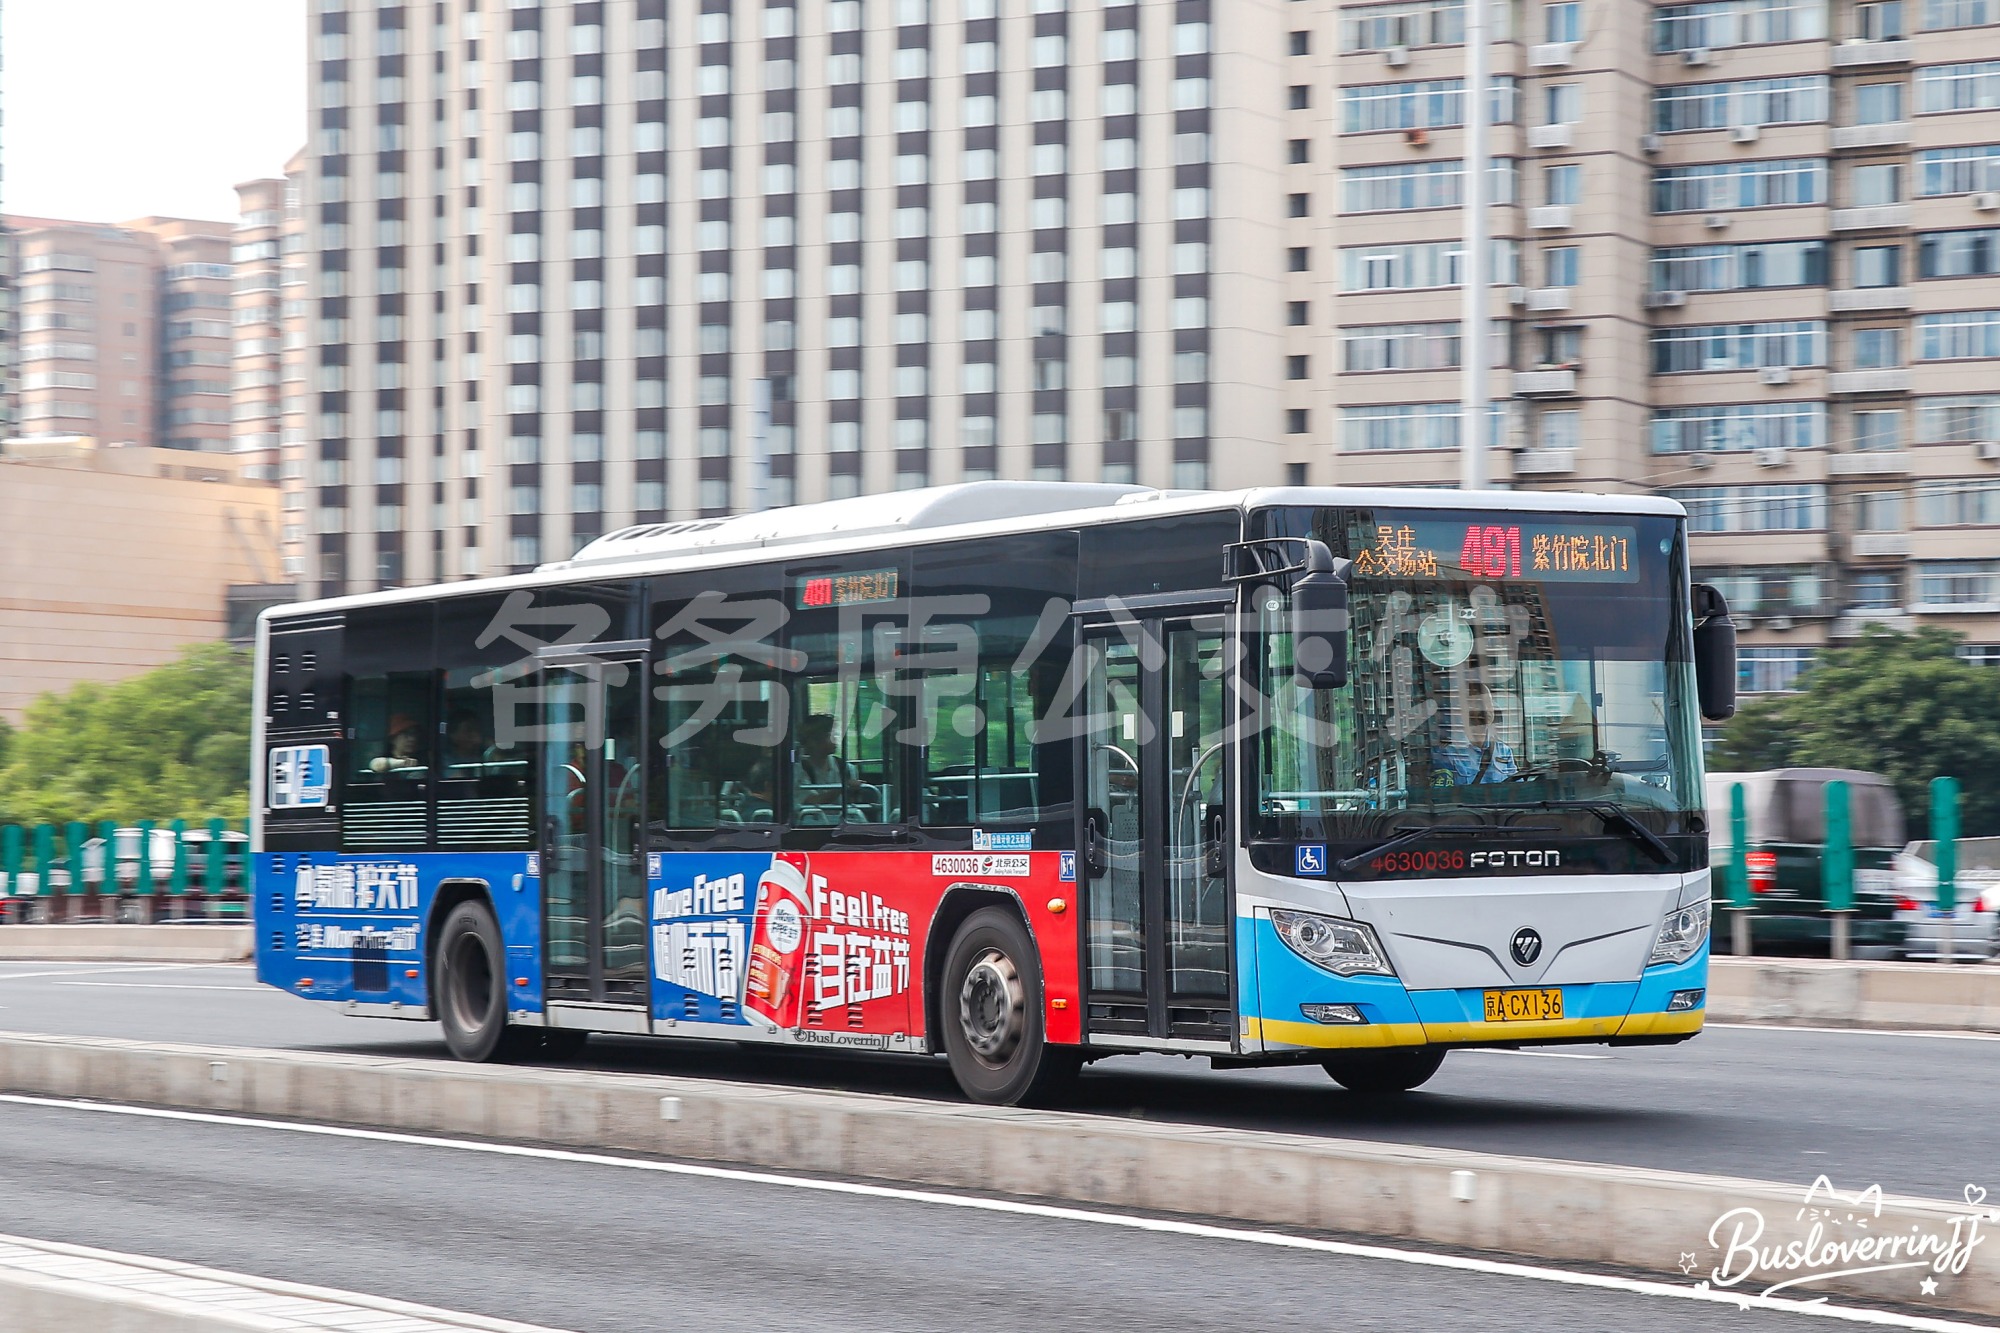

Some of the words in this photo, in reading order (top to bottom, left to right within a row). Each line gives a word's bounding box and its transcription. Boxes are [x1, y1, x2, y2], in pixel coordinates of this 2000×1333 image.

[1375, 525, 1416, 551] 吴庄
[1460, 526, 1520, 577] 481
[1355, 549, 1437, 576] 公交场站
[1531, 534, 1627, 571] 紫竹院北门
[802, 578, 833, 606] 481
[935, 858, 978, 873] 4630036
[995, 858, 1028, 868] 北京公交
[1371, 851, 1464, 871] 4630036
[1470, 850, 1560, 867] FOTON
[653, 888, 693, 920] Move
[694, 873, 744, 914] Free
[812, 873, 869, 928] Feel
[872, 894, 910, 936] Free
[813, 925, 910, 1011] 自在益节
